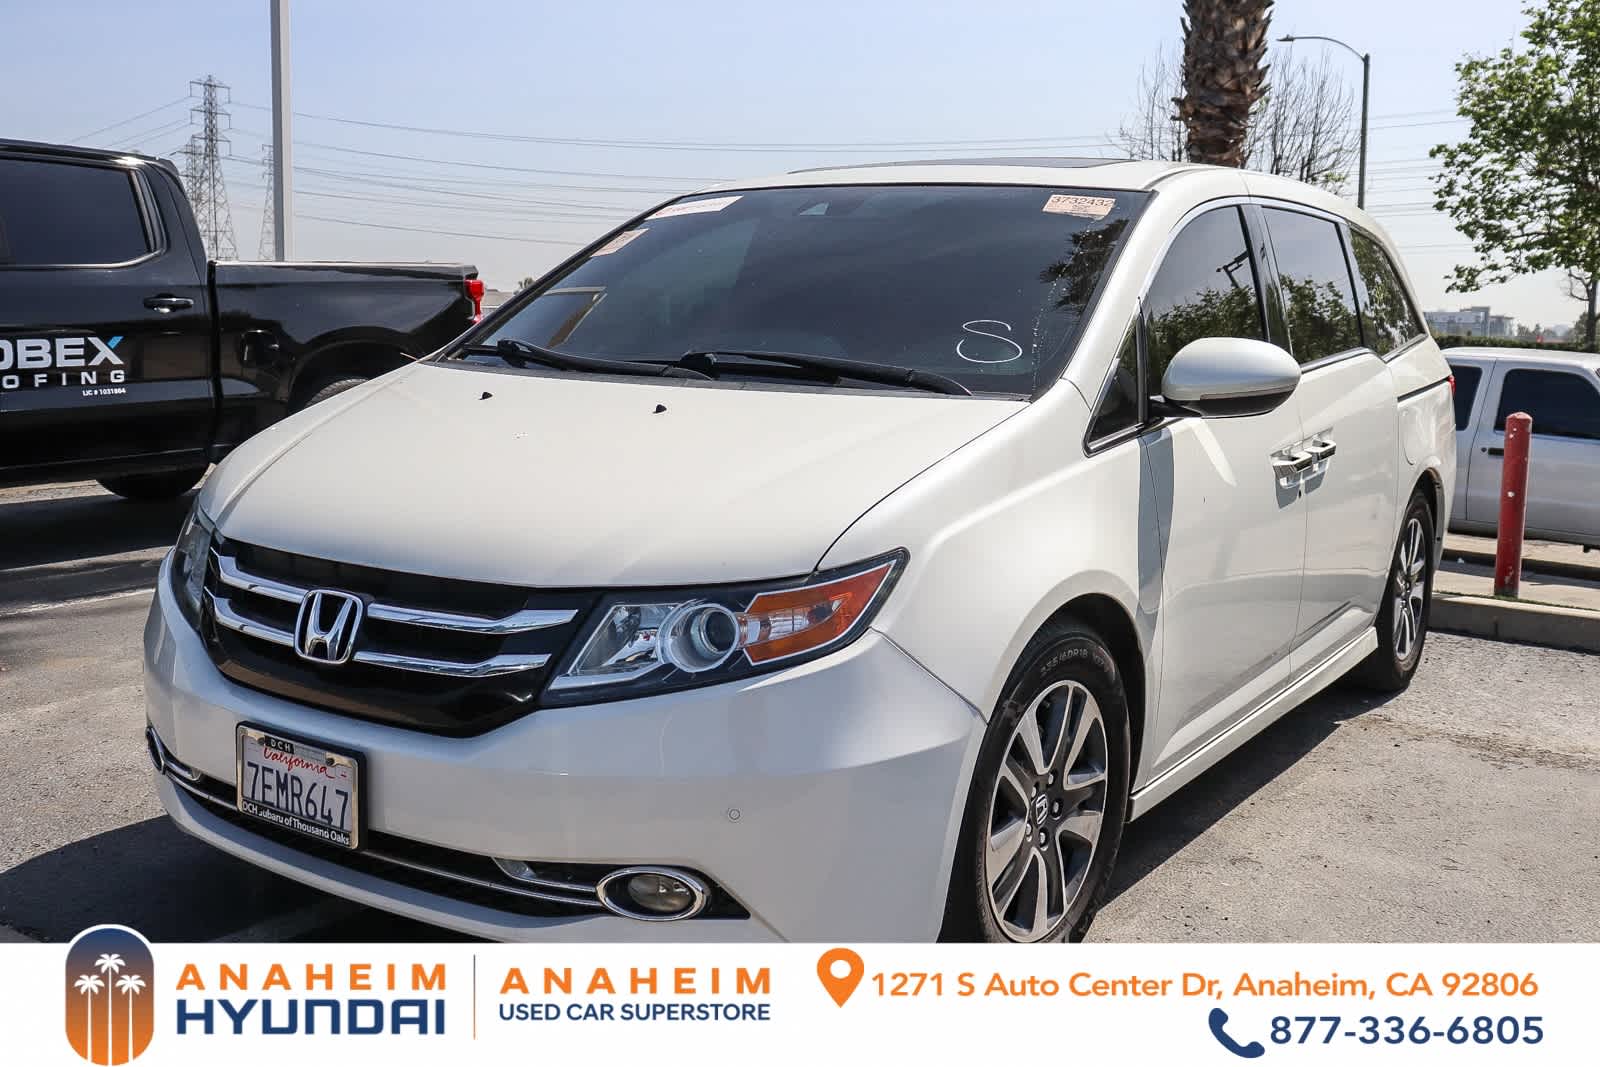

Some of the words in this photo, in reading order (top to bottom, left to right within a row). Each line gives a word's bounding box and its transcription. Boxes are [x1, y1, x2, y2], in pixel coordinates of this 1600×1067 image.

[2, 370, 125, 389] OFING
[271, 741, 291, 752] DCH
[263, 747, 335, 779] California
[247, 761, 348, 830] 7EMR647
[242, 801, 258, 815] DCH
[284, 815, 293, 826] of
[293, 817, 329, 838] Thousand
[330, 830, 349, 845] Oaks
